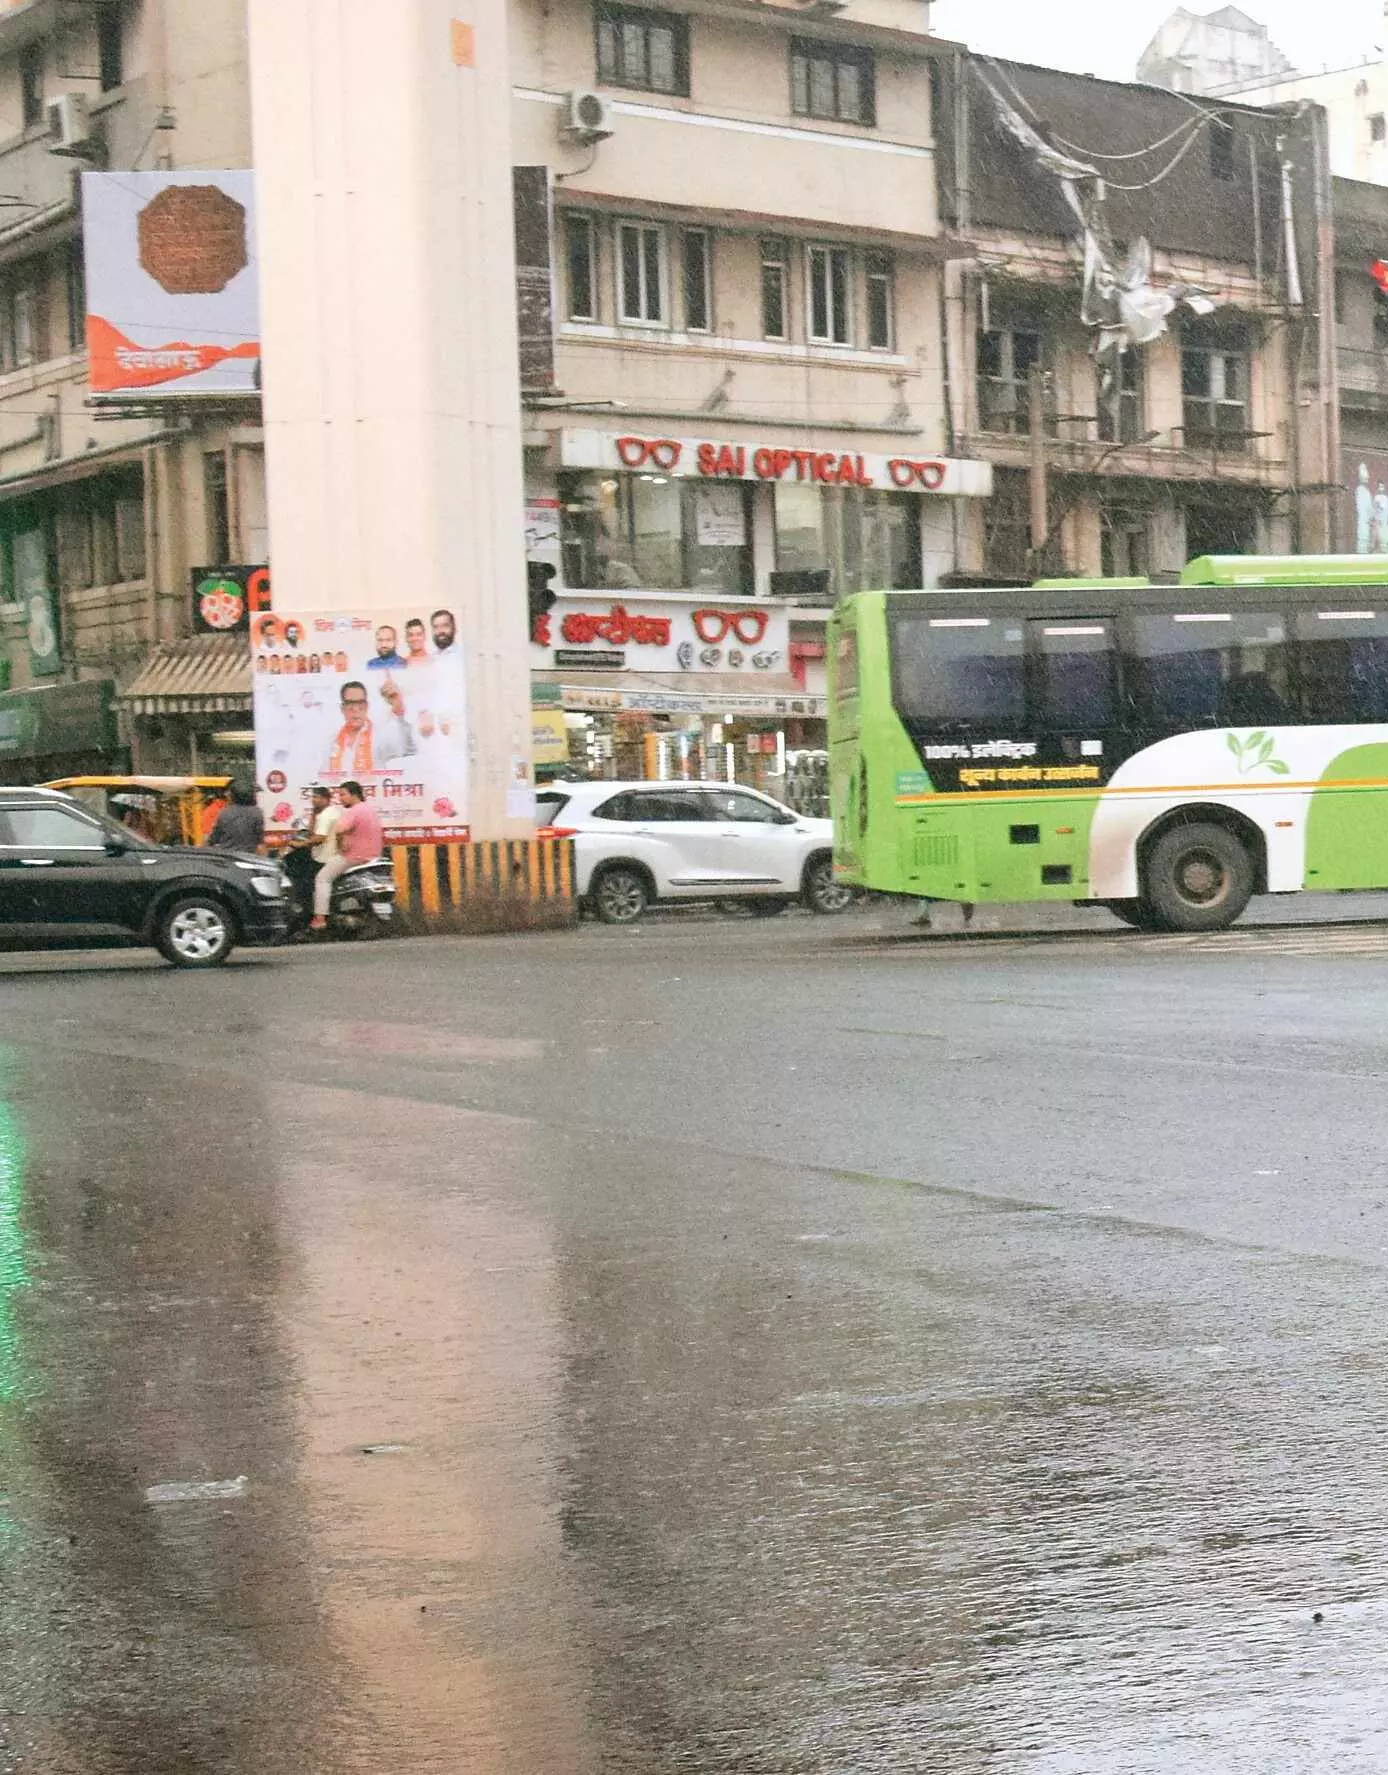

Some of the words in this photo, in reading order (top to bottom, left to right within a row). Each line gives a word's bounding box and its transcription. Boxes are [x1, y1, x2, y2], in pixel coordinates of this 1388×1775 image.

[697, 443, 746, 478] SAI
[753, 447, 873, 487] OPTICAL
[924, 745, 970, 760] 100%
[382, 777, 424, 798] मिश्रा
